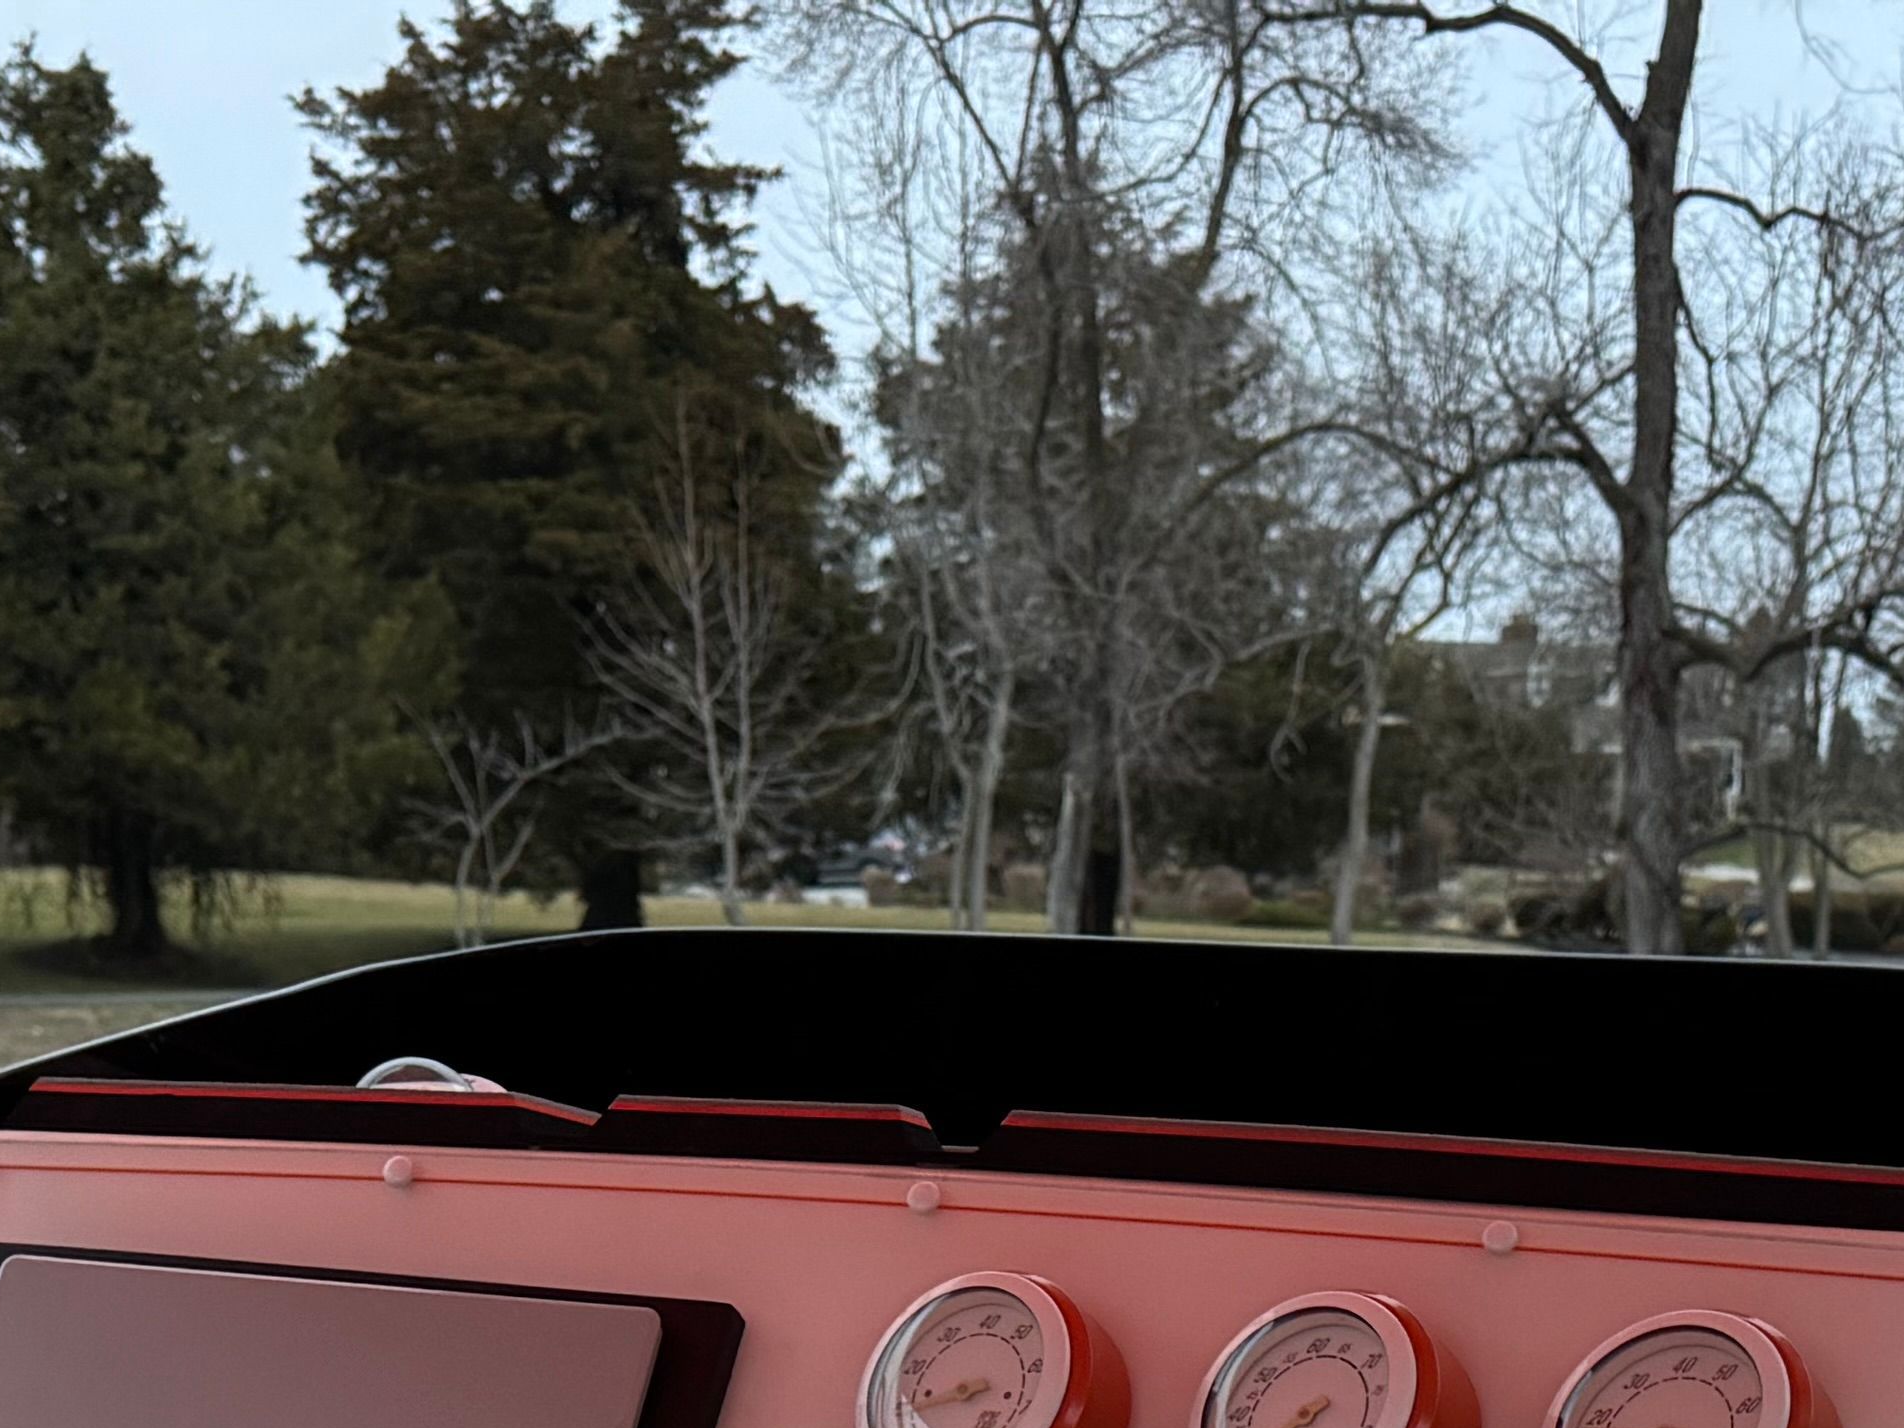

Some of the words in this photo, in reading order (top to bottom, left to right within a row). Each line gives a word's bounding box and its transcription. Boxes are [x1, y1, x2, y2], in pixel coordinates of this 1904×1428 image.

[1672, 1357, 1697, 1373] 40
[1711, 1364, 1738, 1381] 50
[1623, 1373, 1650, 1390] 30
[1735, 1396, 1762, 1414] 60
[1585, 1408, 1612, 1426] 20
